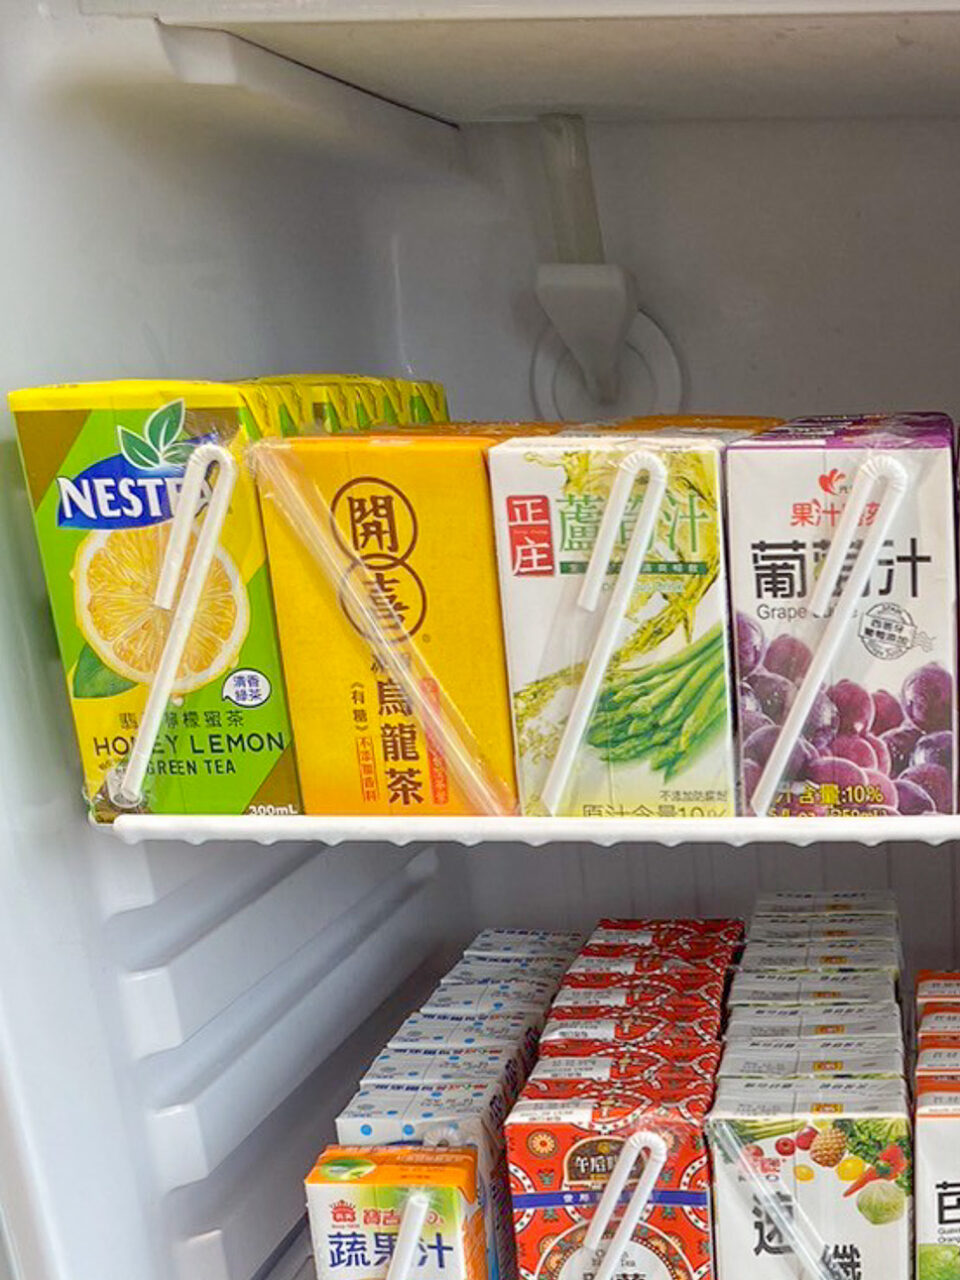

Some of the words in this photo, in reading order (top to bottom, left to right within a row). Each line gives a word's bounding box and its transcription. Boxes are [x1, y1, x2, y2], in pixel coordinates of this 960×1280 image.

[57, 475, 215, 520] NESTE
[789, 501, 883, 527] 果汁
[508, 498, 554, 575] 正庄
[119, 710, 245, 729] 翡檸檬蜜茶
[190, 732, 285, 754] LEMON
[377, 678, 424, 806] 烏龍茶
[204, 758, 237, 775] TEA
[774, 783, 884, 806] 汁含量:10%
[327, 1231, 455, 1269] 蔬果汁
